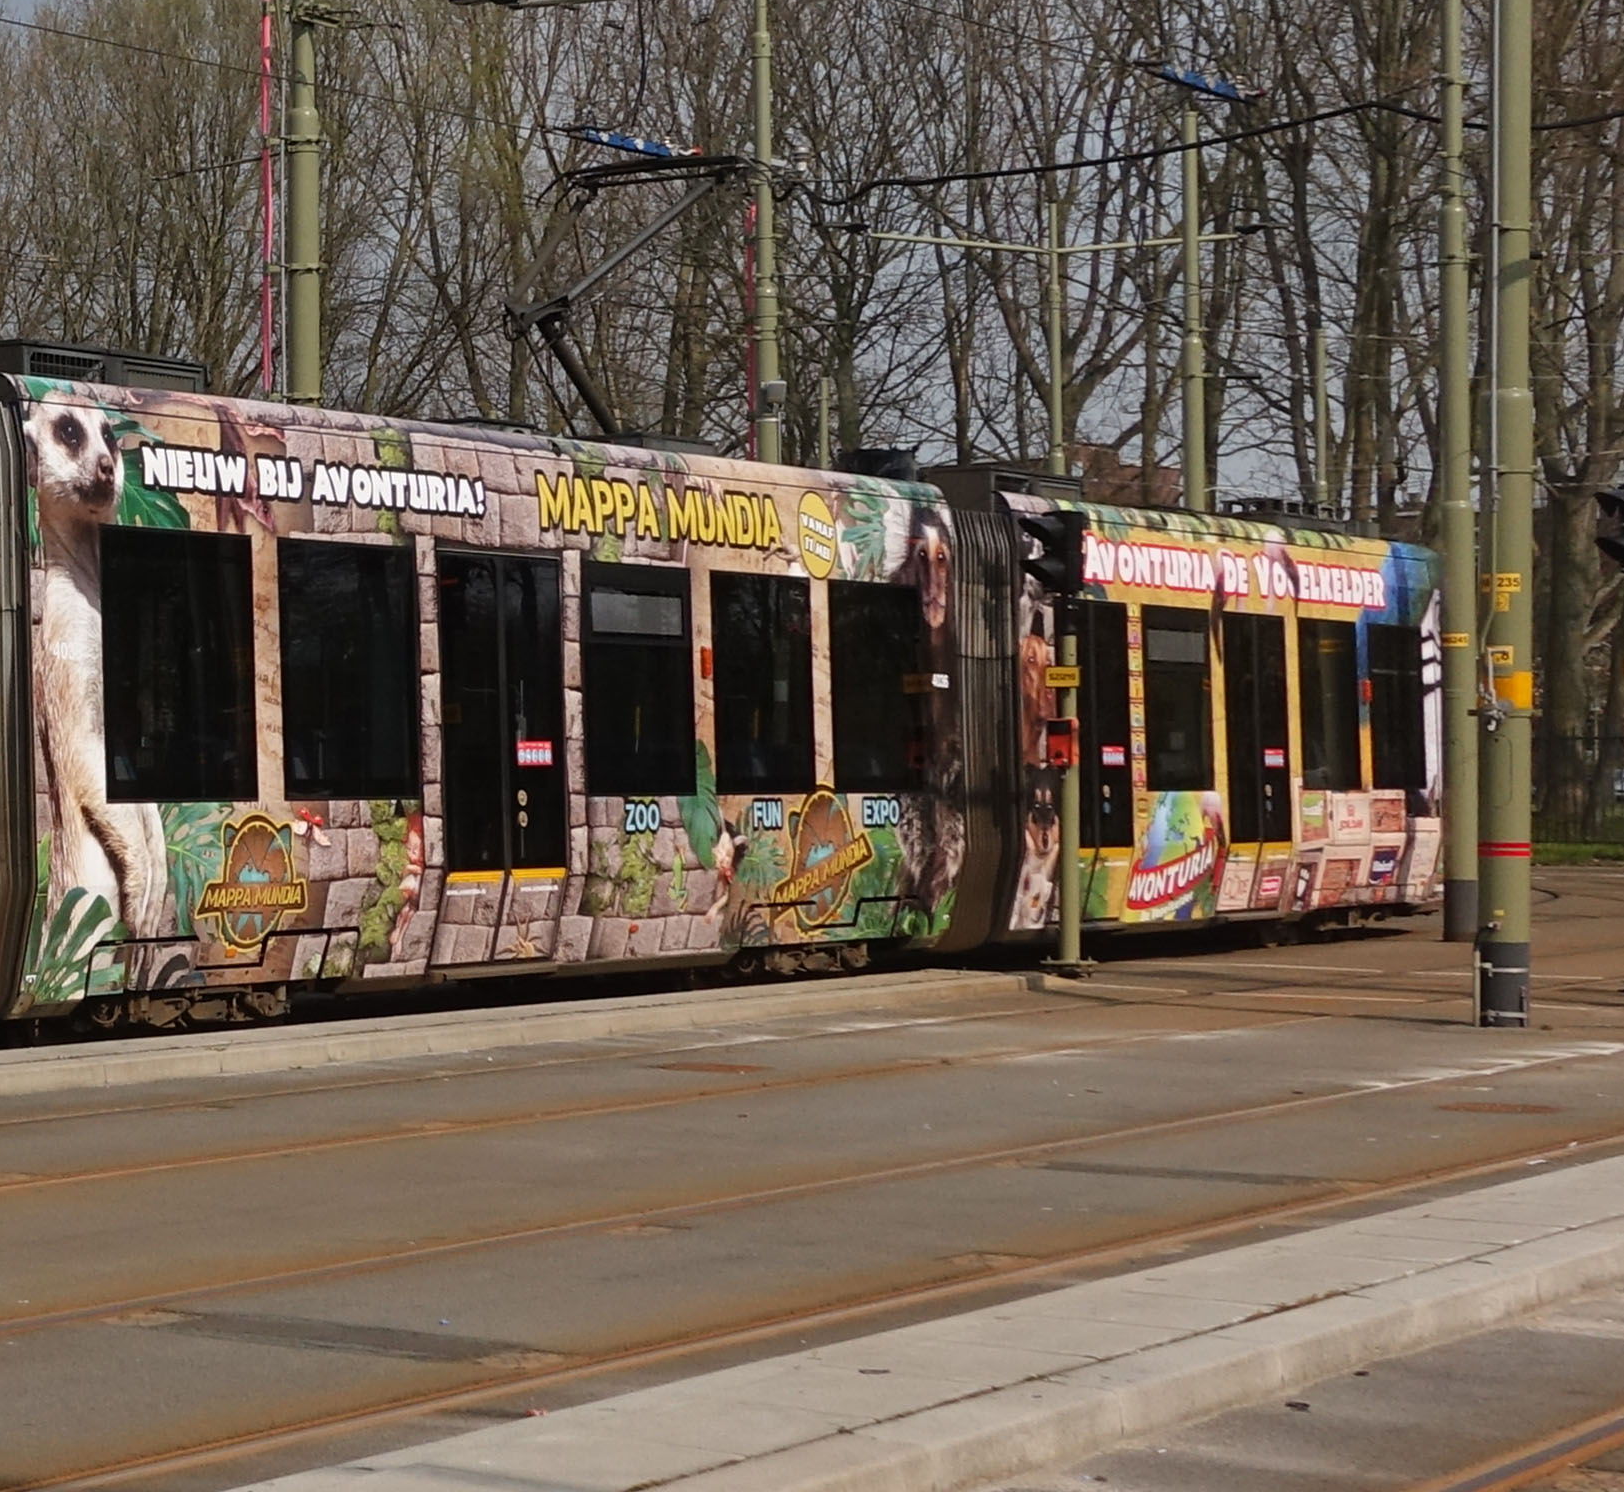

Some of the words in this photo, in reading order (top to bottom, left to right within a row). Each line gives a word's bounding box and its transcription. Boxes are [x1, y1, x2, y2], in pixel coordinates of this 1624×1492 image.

[143, 446, 247, 492] NIEUW
[257, 458, 302, 499] BIJ
[313, 464, 485, 514] AVONTURIA!
[536, 473, 660, 539] MAPPA
[667, 488, 783, 547] MUNDIA
[799, 513, 835, 539] VANAF
[1084, 535, 1216, 590] AVONTURIA
[1224, 555, 1248, 594] DE
[625, 801, 660, 832] ZOO
[753, 800, 782, 828] FUN
[863, 798, 900, 826] EXPO
[775, 868, 821, 903] MAPPA
[1128, 841, 1214, 903] AVONTURIA
[205, 888, 251, 908] MAPPA
[252, 886, 301, 905] MUNDIA
